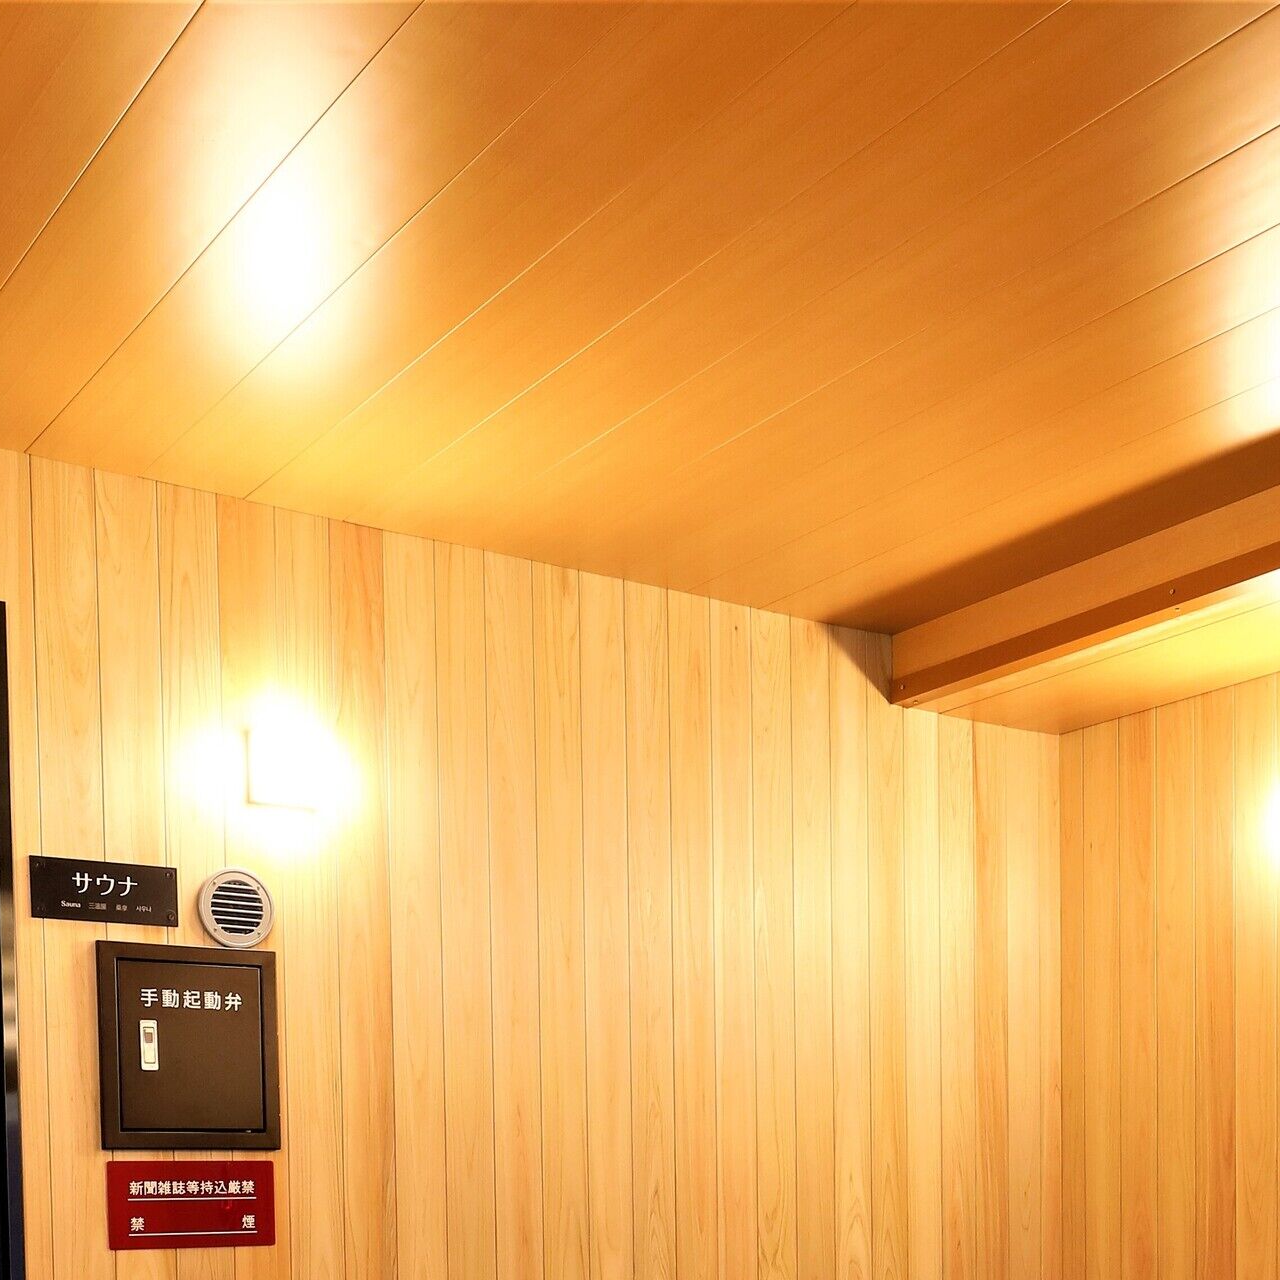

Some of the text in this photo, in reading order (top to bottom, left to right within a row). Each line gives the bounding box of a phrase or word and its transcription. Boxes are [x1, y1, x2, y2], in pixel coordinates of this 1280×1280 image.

[72, 872, 138, 896] サウナ
[61, 900, 81, 908] Sauna
[140, 988, 242, 1011] 手動起動弁
[129, 1180, 255, 1195] 新聞雑誌等持込厳禁
